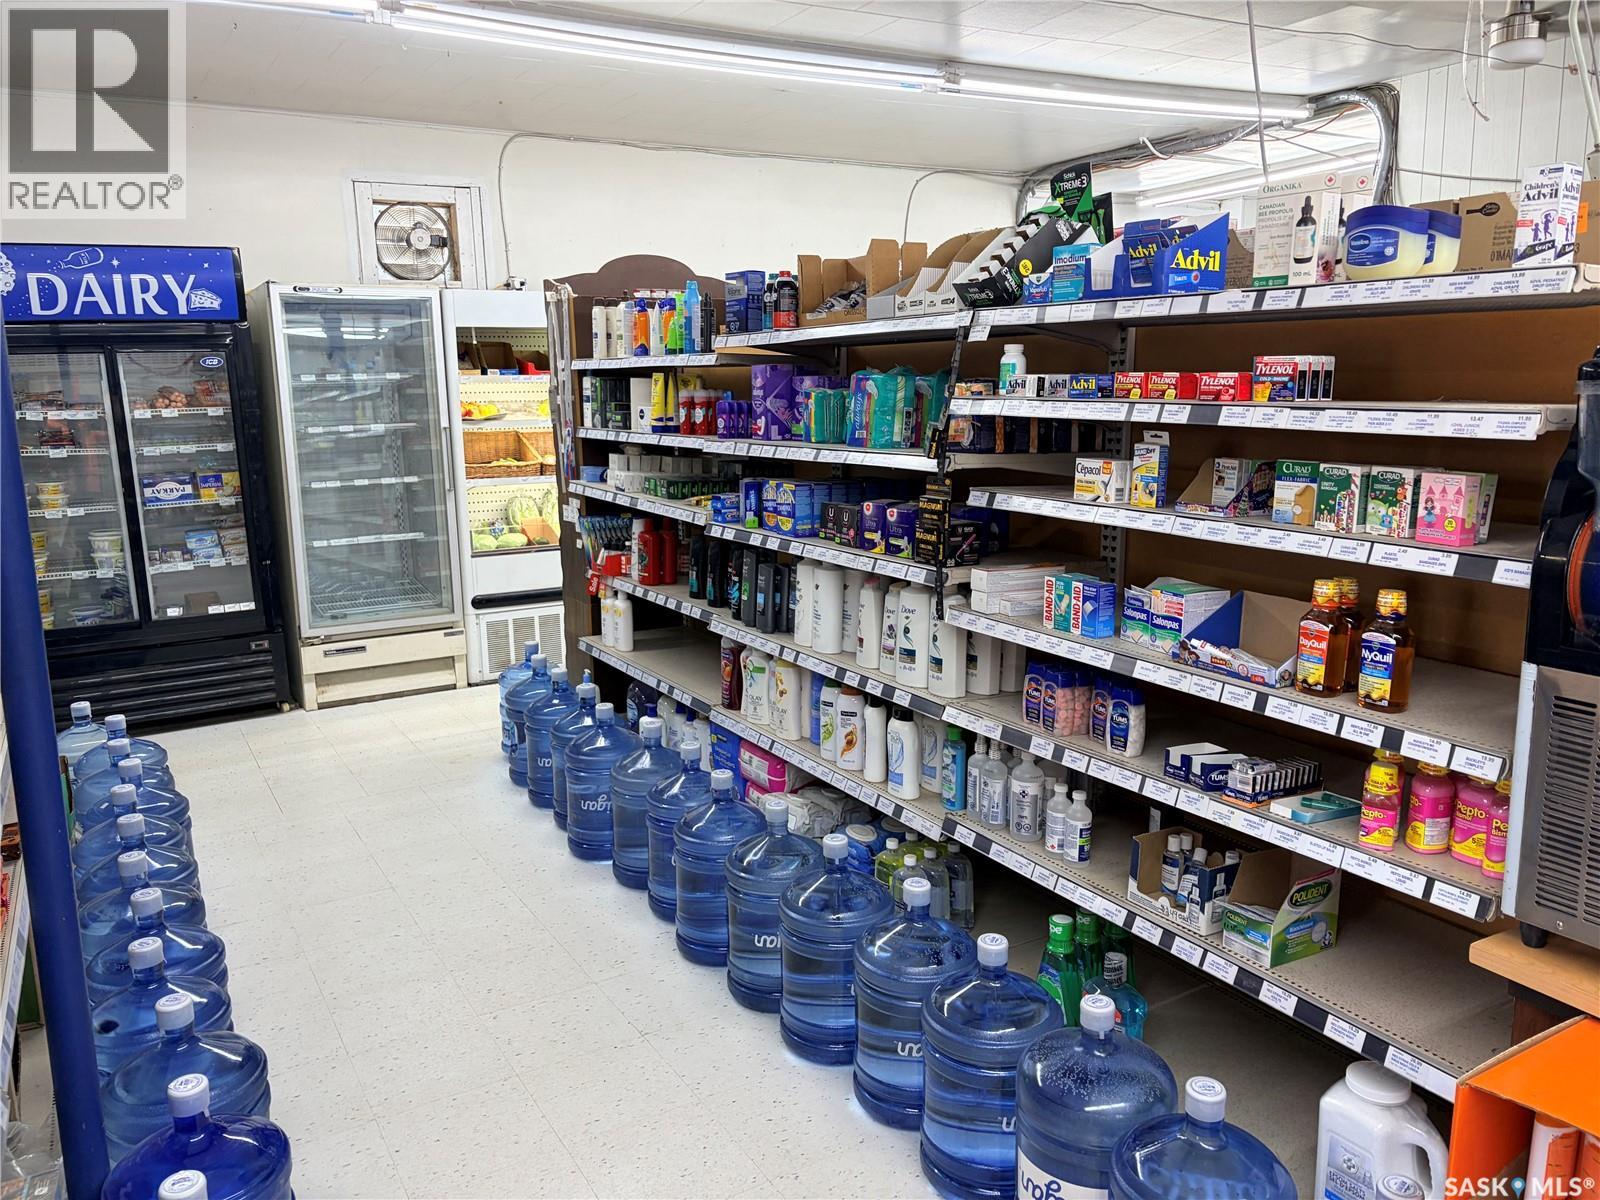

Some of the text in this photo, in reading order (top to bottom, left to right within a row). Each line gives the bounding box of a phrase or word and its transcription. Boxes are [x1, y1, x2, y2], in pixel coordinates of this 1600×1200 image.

[1263, 181, 1302, 194] ORGANIKA
[1524, 180, 1559, 191] Children's
[1562, 181, 1580, 194] Advil
[1521, 188, 1559, 202] Advil
[1258, 202, 1286, 211] CANADIAN
[1268, 208, 1294, 216] PROPOLIS
[1128, 243, 1158, 259] Advil
[1054, 255, 1087, 265] Imodium
[1170, 247, 1221, 272] Advil
[26, 273, 196, 316] DAIRY
[1255, 364, 1295, 375] TYLENOL
[1007, 379, 1026, 389] Advil
[1048, 379, 1067, 389] Advil
[1070, 378, 1096, 390] Advil
[1116, 375, 1142, 384] TYLENOL
[1151, 375, 1177, 384] TYLENOL
[1200, 376, 1236, 385] TYLENOL
[1076, 462, 1101, 477] Cépacol
[1283, 464, 1312, 474] CURAD
[1324, 467, 1348, 476] CURAD
[1378, 471, 1401, 480] CURAD
[151, 486, 186, 496] PARKAY
[919, 501, 943, 511] MAGNUM
[916, 531, 937, 541] MAGNUM
[1045, 579, 1054, 622] BAND-AID
[901, 605, 917, 614] Dove
[1072, 586, 1082, 630] BAND-AID
[1123, 606, 1148, 620] Salonpas
[1152, 615, 1180, 629] Salonpas
[1299, 636, 1327, 649] DayQuil
[1361, 648, 1393, 664] NyQuil
[1112, 714, 1128, 724] TUMS
[1292, 883, 1329, 904] POLIDENT
[1226, 911, 1249, 926] POLIDENT
